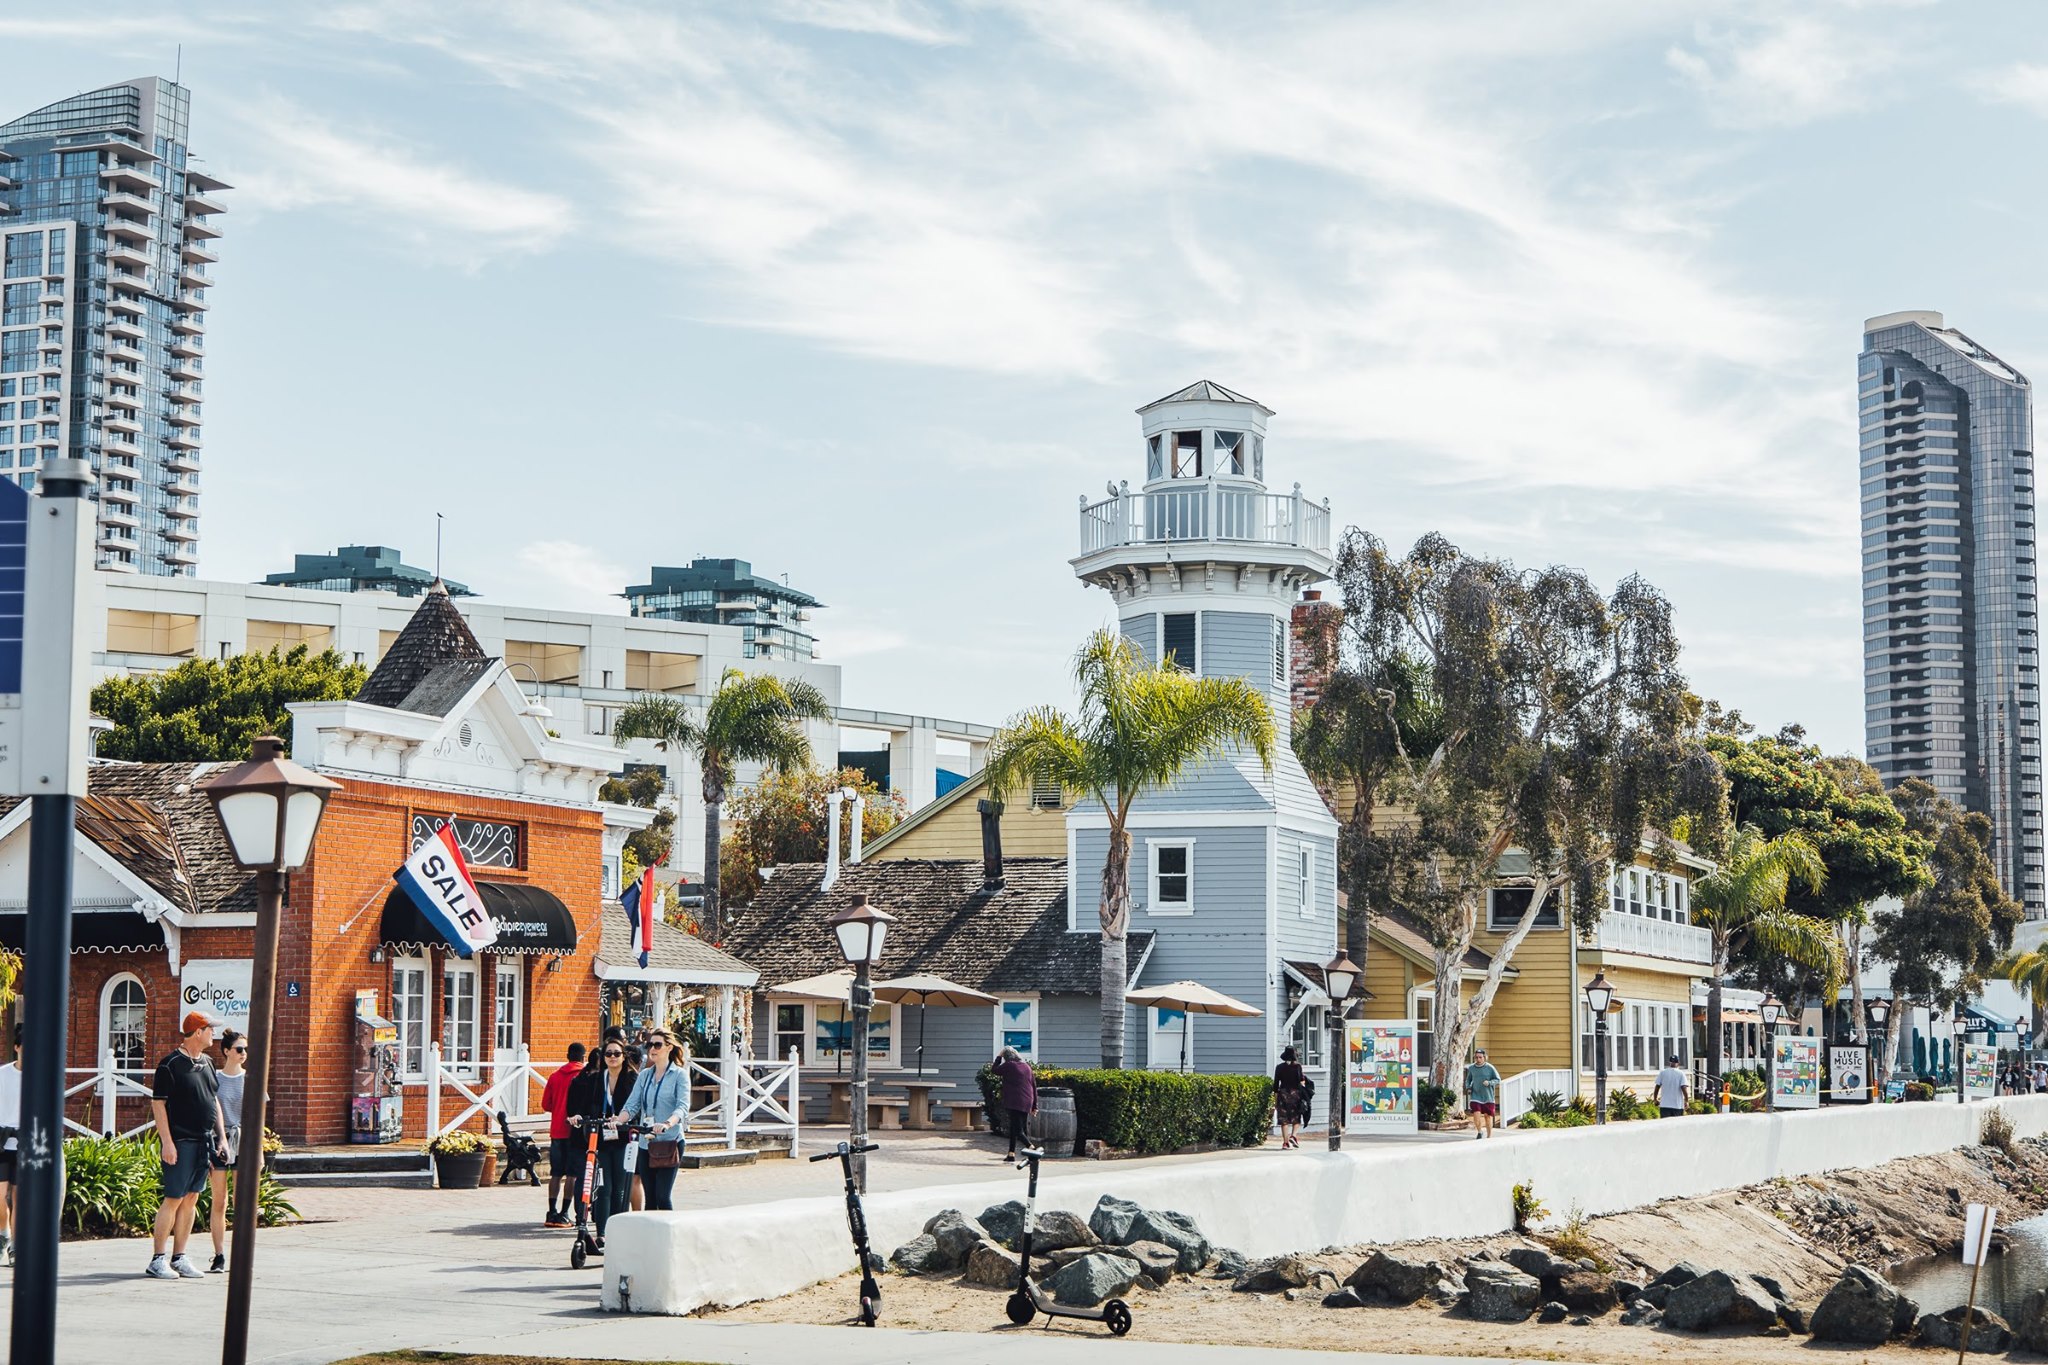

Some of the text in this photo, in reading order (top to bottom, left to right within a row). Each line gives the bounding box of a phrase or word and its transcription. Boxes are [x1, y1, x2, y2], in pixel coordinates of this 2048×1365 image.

[421, 854, 484, 931] SALE
[183, 981, 235, 1006] eclipse
[215, 999, 250, 1017] eyew
[1967, 1017, 1987, 1028] LLY'S
[1833, 1058, 1863, 1066] MUSIC
[1837, 1050, 1859, 1059] LIVE
[582, 1160, 595, 1196] JUMP
